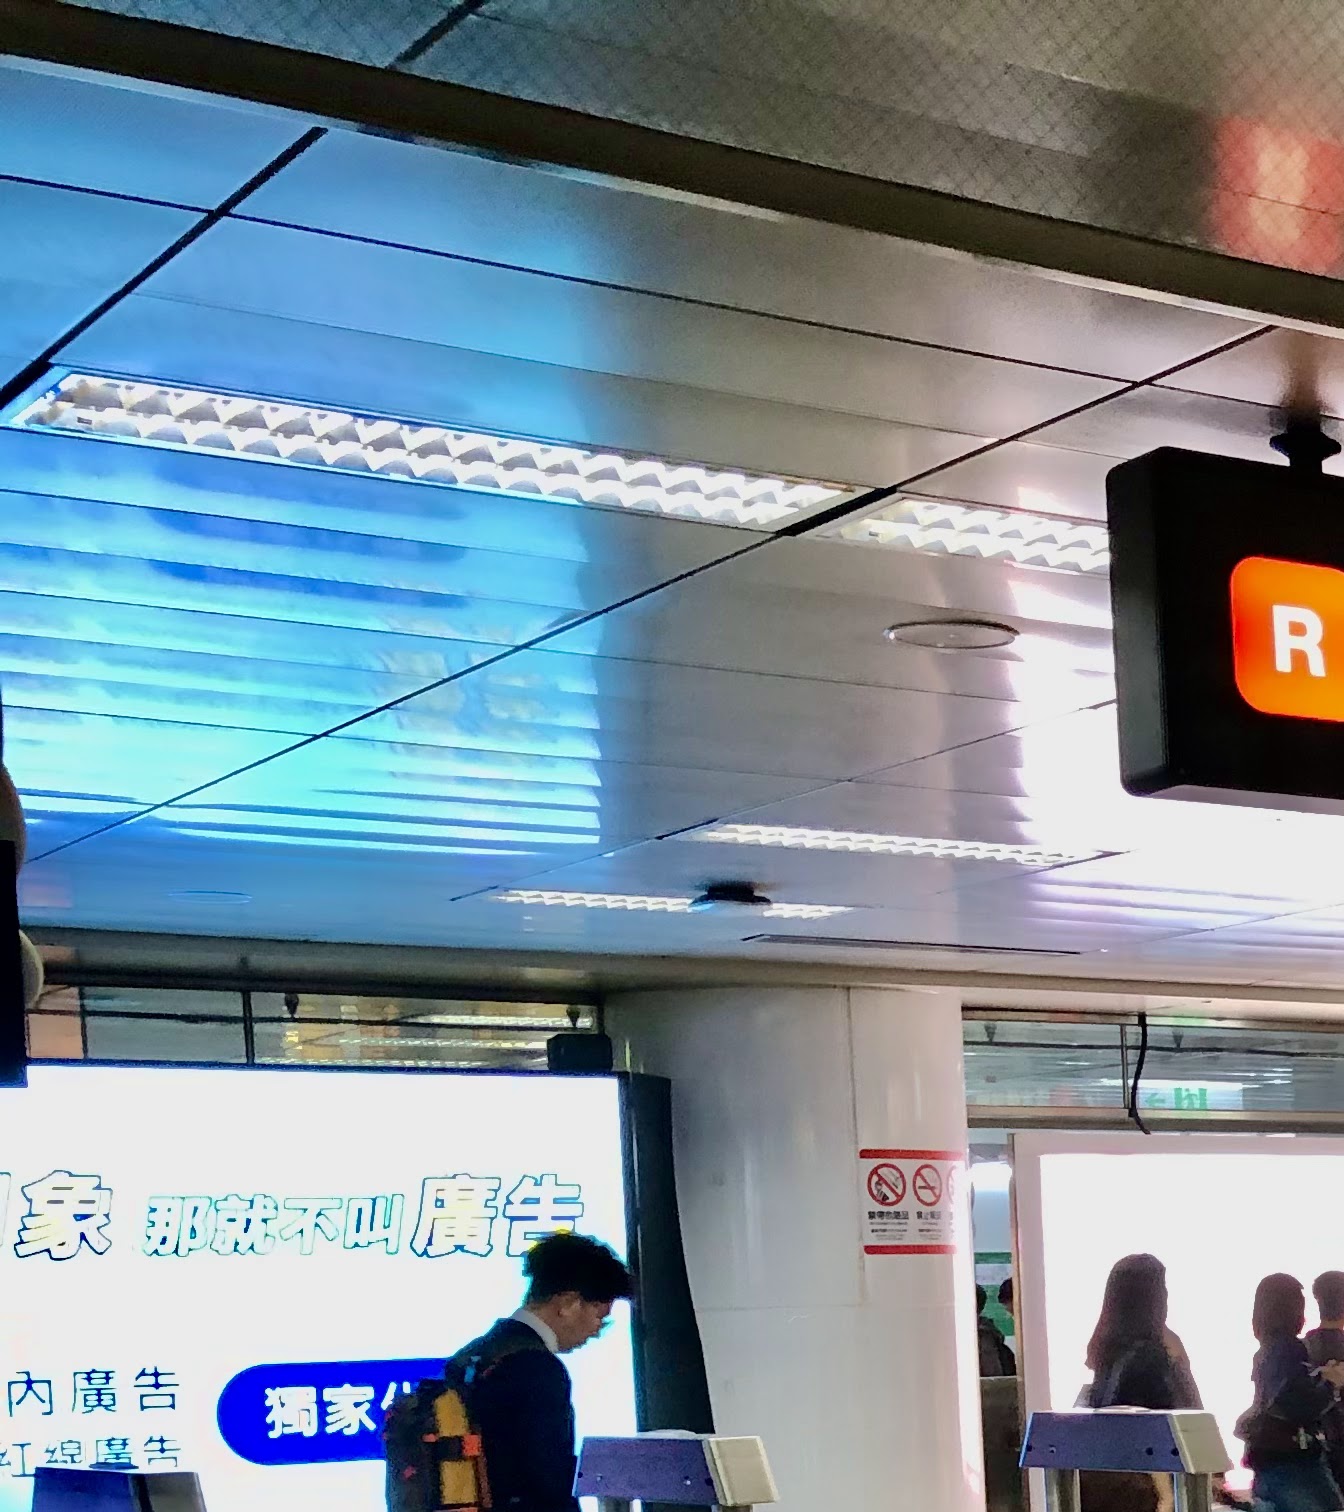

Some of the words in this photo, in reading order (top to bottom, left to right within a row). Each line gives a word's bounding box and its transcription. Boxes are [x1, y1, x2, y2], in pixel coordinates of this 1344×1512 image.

[1272, 604, 1327, 677] R
[143, 1173, 585, 1260] 那就不叫廣告
[7, 1366, 180, 1417] 內廣告
[265, 1381, 413, 1438] 獨家
